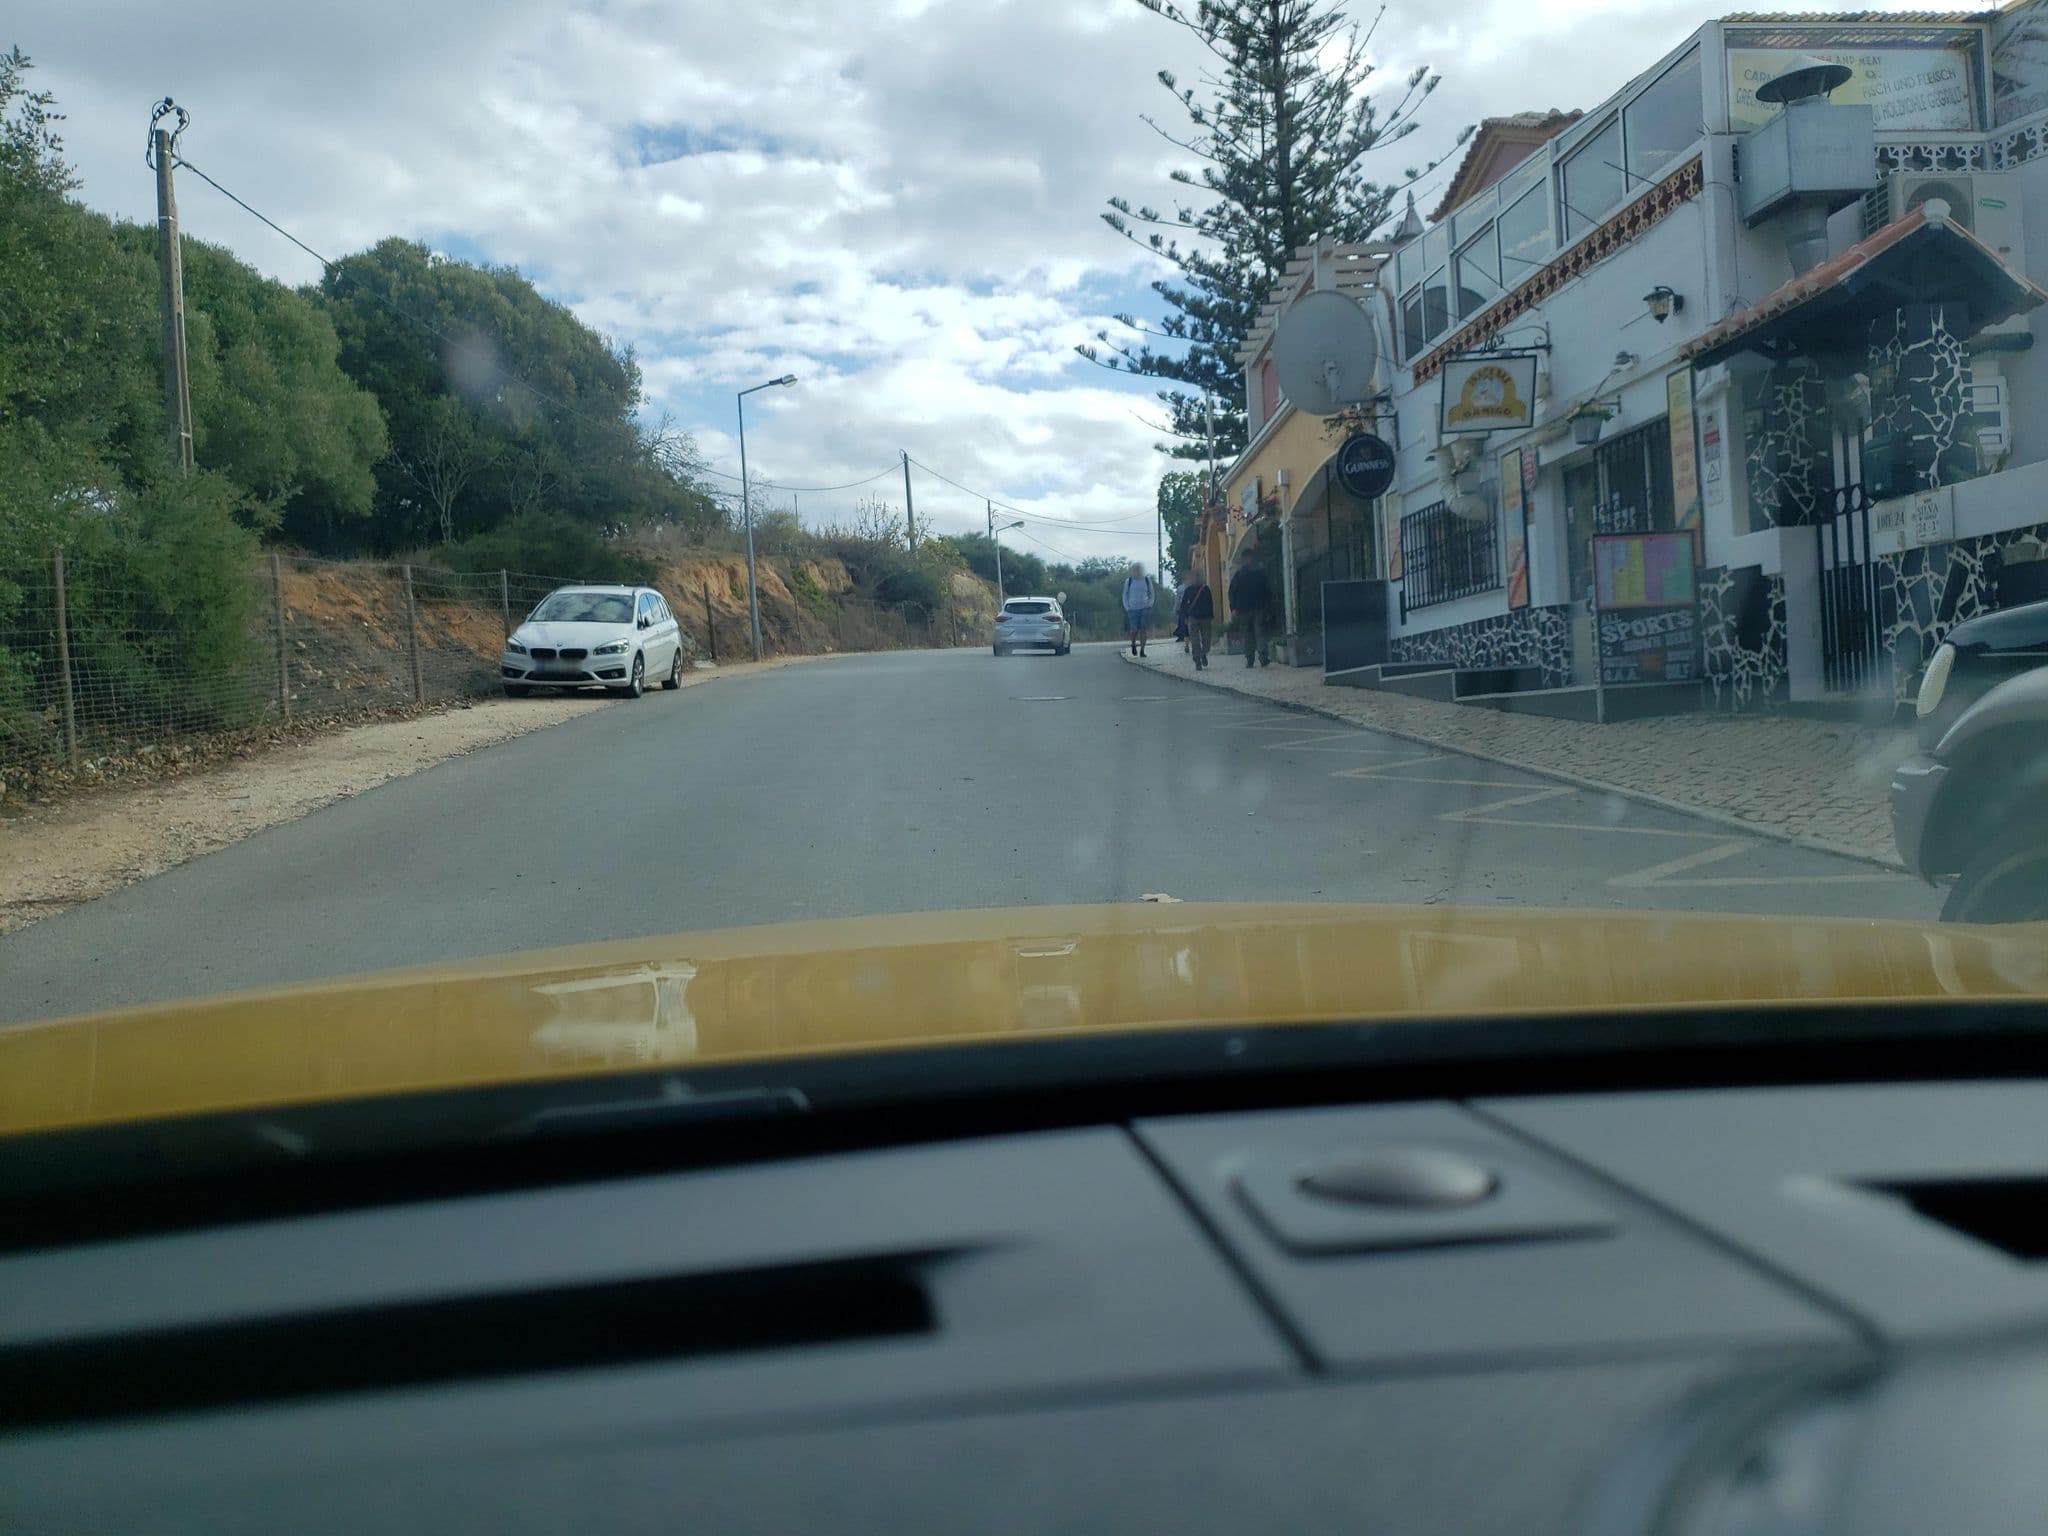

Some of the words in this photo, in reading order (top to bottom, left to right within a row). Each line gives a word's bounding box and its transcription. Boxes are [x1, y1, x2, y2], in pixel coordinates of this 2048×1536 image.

[1893, 76, 1915, 91] UND
[1917, 69, 1956, 86] FLEISCH
[1600, 609, 1694, 643] SPORTS
